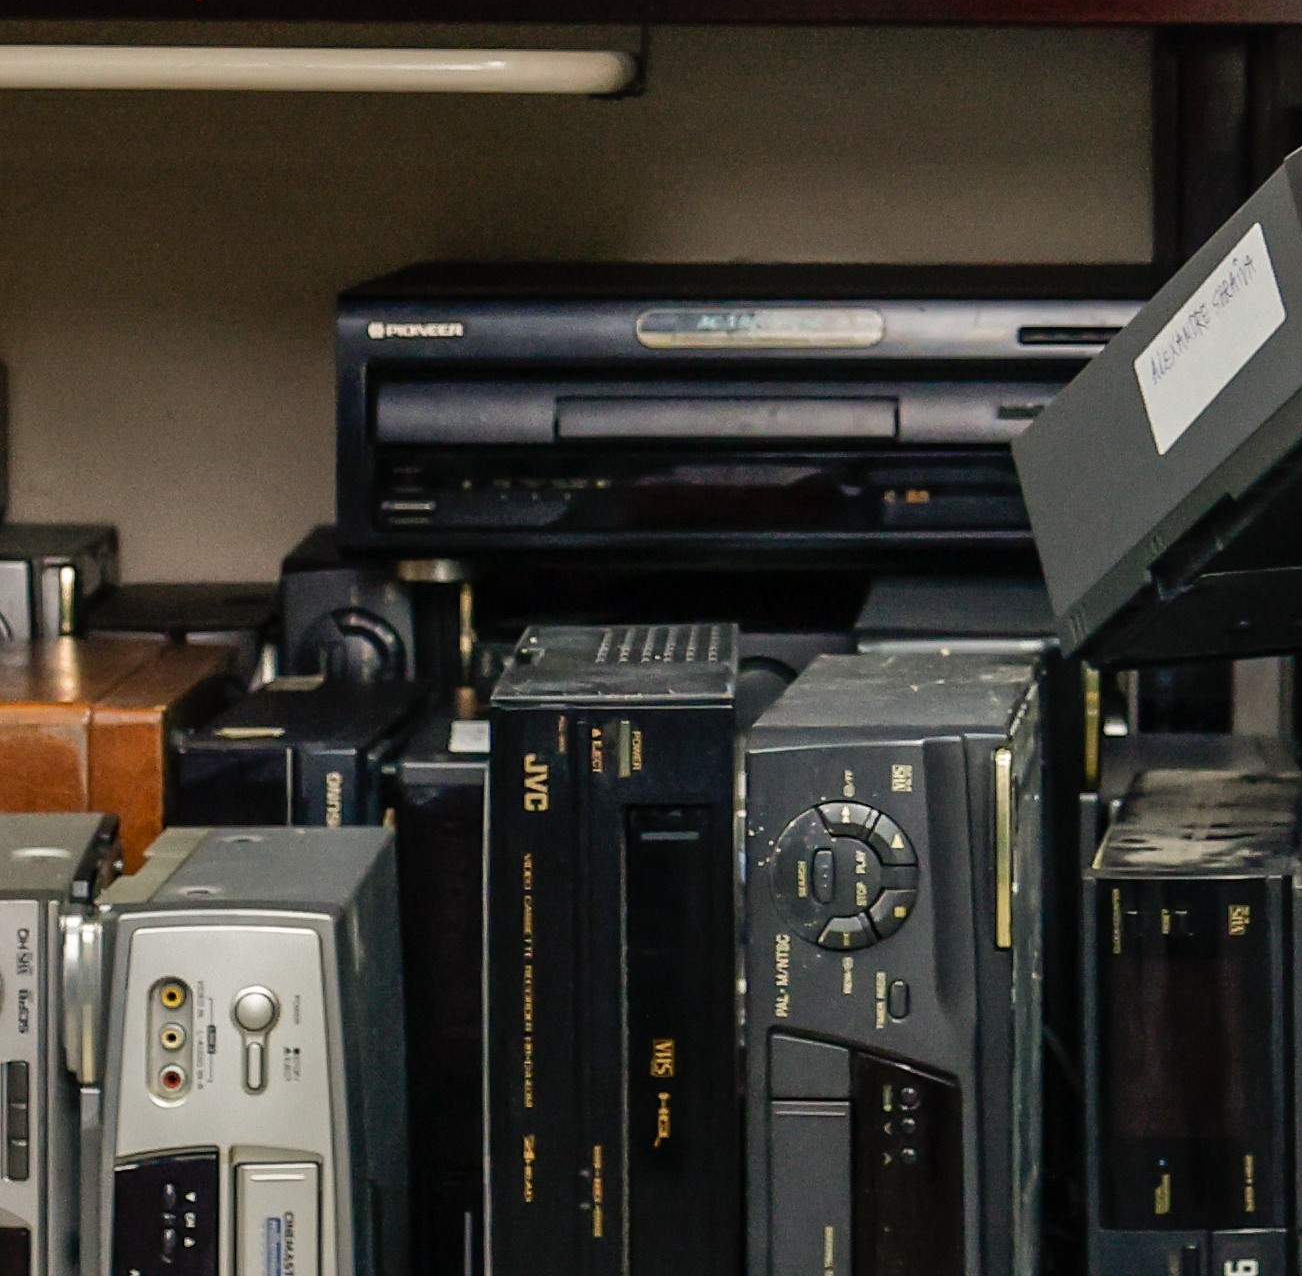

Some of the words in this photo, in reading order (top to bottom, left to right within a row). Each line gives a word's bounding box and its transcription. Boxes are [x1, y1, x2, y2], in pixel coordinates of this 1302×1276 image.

[385, 322, 464, 338] PIONEER
[631, 729, 643, 770] POWER
[523, 752, 549, 812] JVC
[855, 850, 867, 875] PLAY
[650, 1038, 675, 1077] VHS
